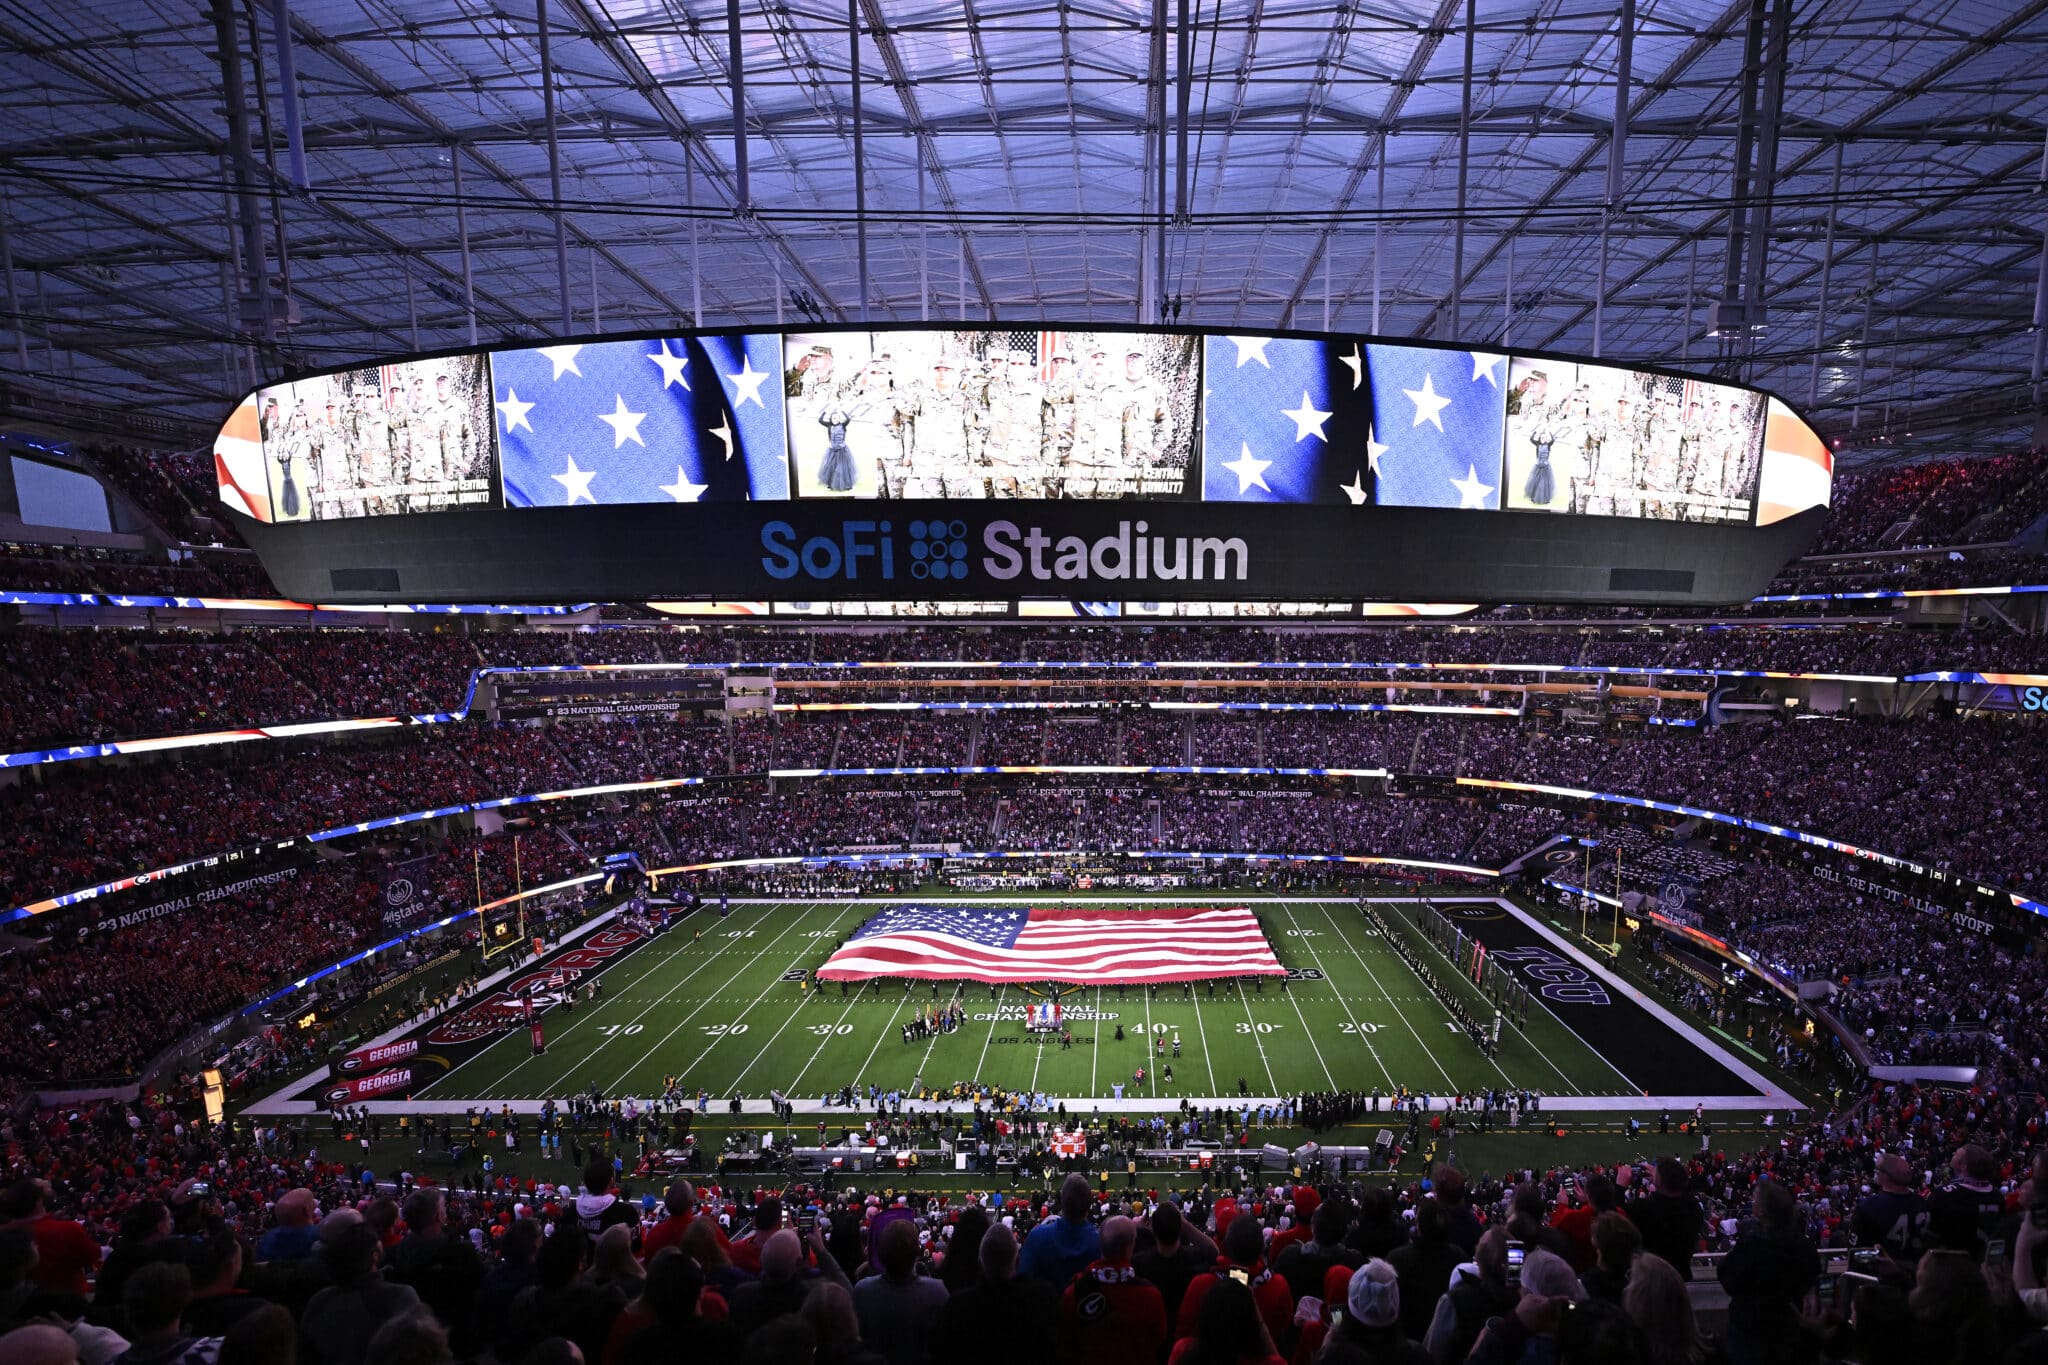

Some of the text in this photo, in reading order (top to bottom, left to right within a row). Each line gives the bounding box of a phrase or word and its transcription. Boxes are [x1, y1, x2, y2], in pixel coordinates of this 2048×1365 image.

[1146, 468, 1184, 479] CENTRAL
[761, 520, 1249, 580] SoFi Stadium
[570, 706, 615, 715] NATIONAL
[617, 703, 680, 712] CHAMPIONSHIP
[204, 857, 218, 867] 7:10
[601, 862, 628, 870] TCU
[1910, 863, 1923, 874] 7:10
[1934, 871, 1943, 880] 25
[119, 896, 192, 929] NATIONAL
[383, 902, 425, 923] Allstate
[1489, 946, 1611, 1004] TCU
[602, 1024, 644, 1036] 10
[704, 1024, 749, 1036] 20
[813, 1024, 854, 1036] 30
[1131, 1023, 1169, 1034] 40
[1235, 1022, 1273, 1033] 30
[1338, 1022, 1379, 1033] 20
[989, 1037, 1019, 1045] LOS
[369, 1040, 418, 1062] GEORGIA
[358, 1069, 411, 1092] GEORGIA
